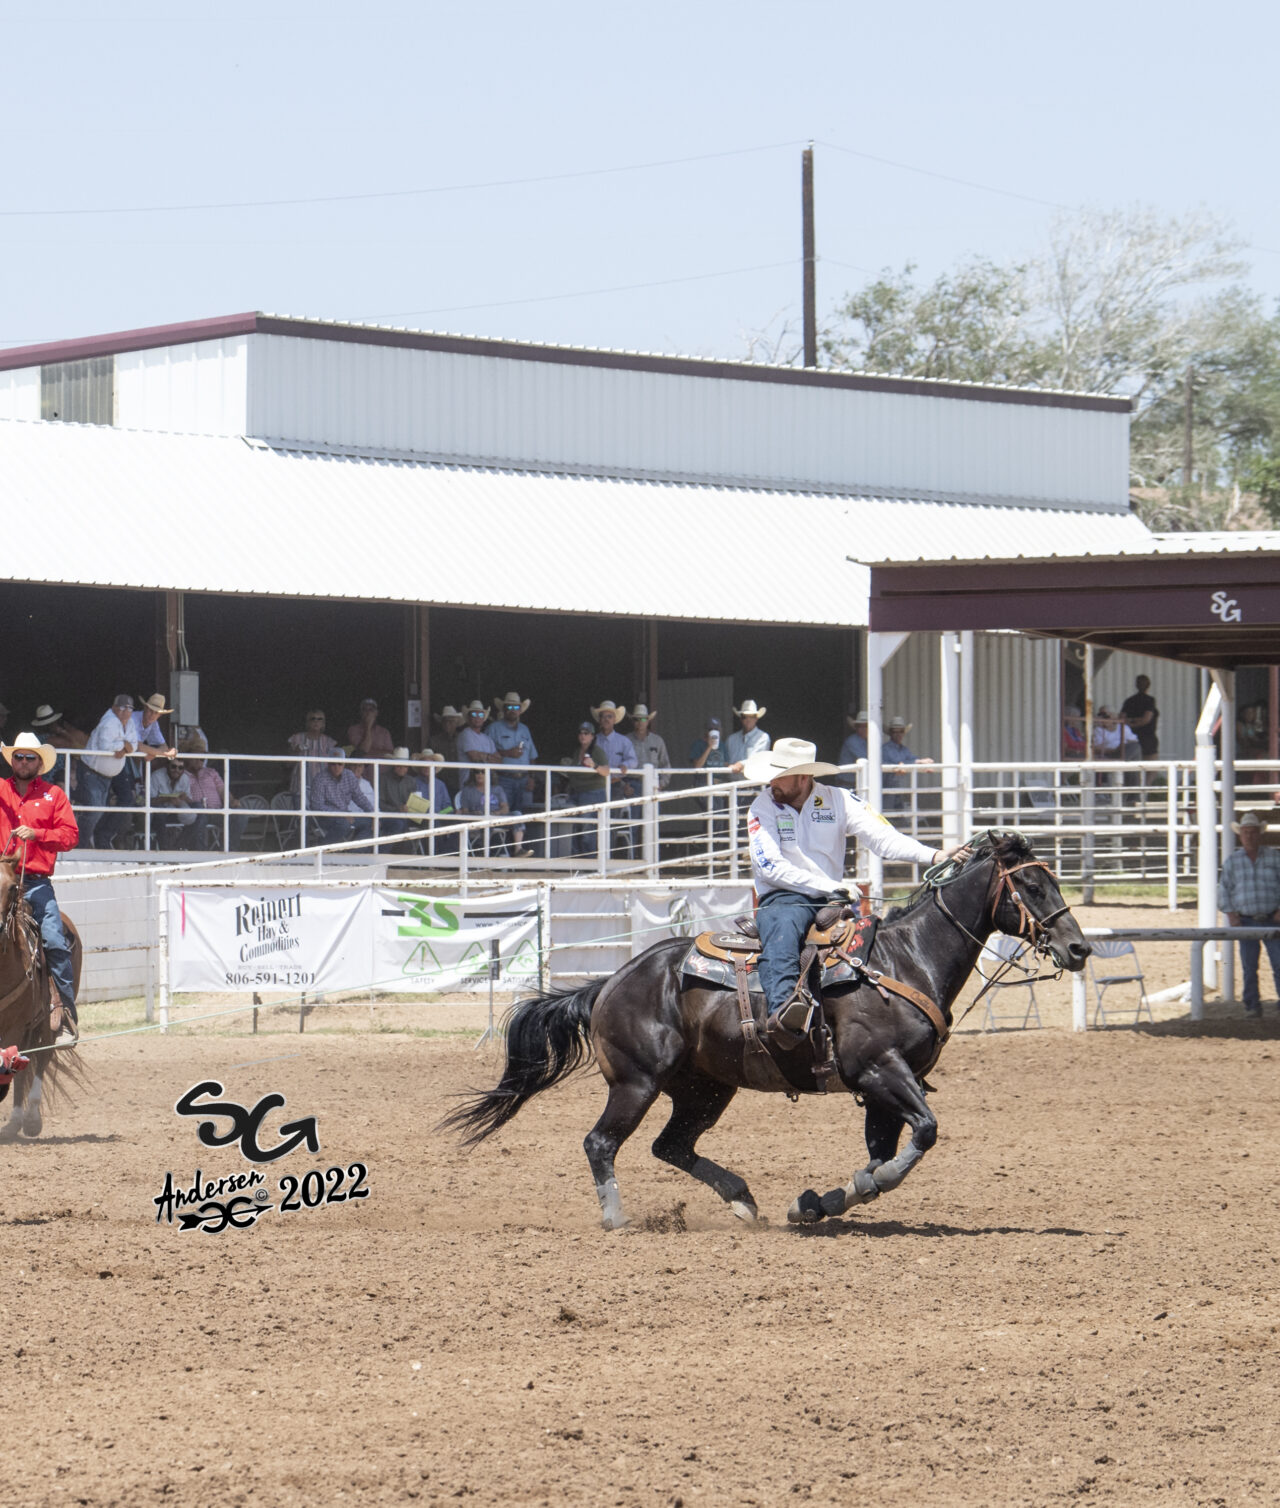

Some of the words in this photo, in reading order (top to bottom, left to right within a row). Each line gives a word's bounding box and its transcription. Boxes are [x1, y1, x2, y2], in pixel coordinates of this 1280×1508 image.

[811, 811, 836, 820] Classic
[235, 893, 302, 936] Reinert
[258, 924, 277, 942] Hay
[279, 920, 290, 934] &
[240, 935, 300, 963] Commodities
[225, 972, 316, 985] 806-591-1201
